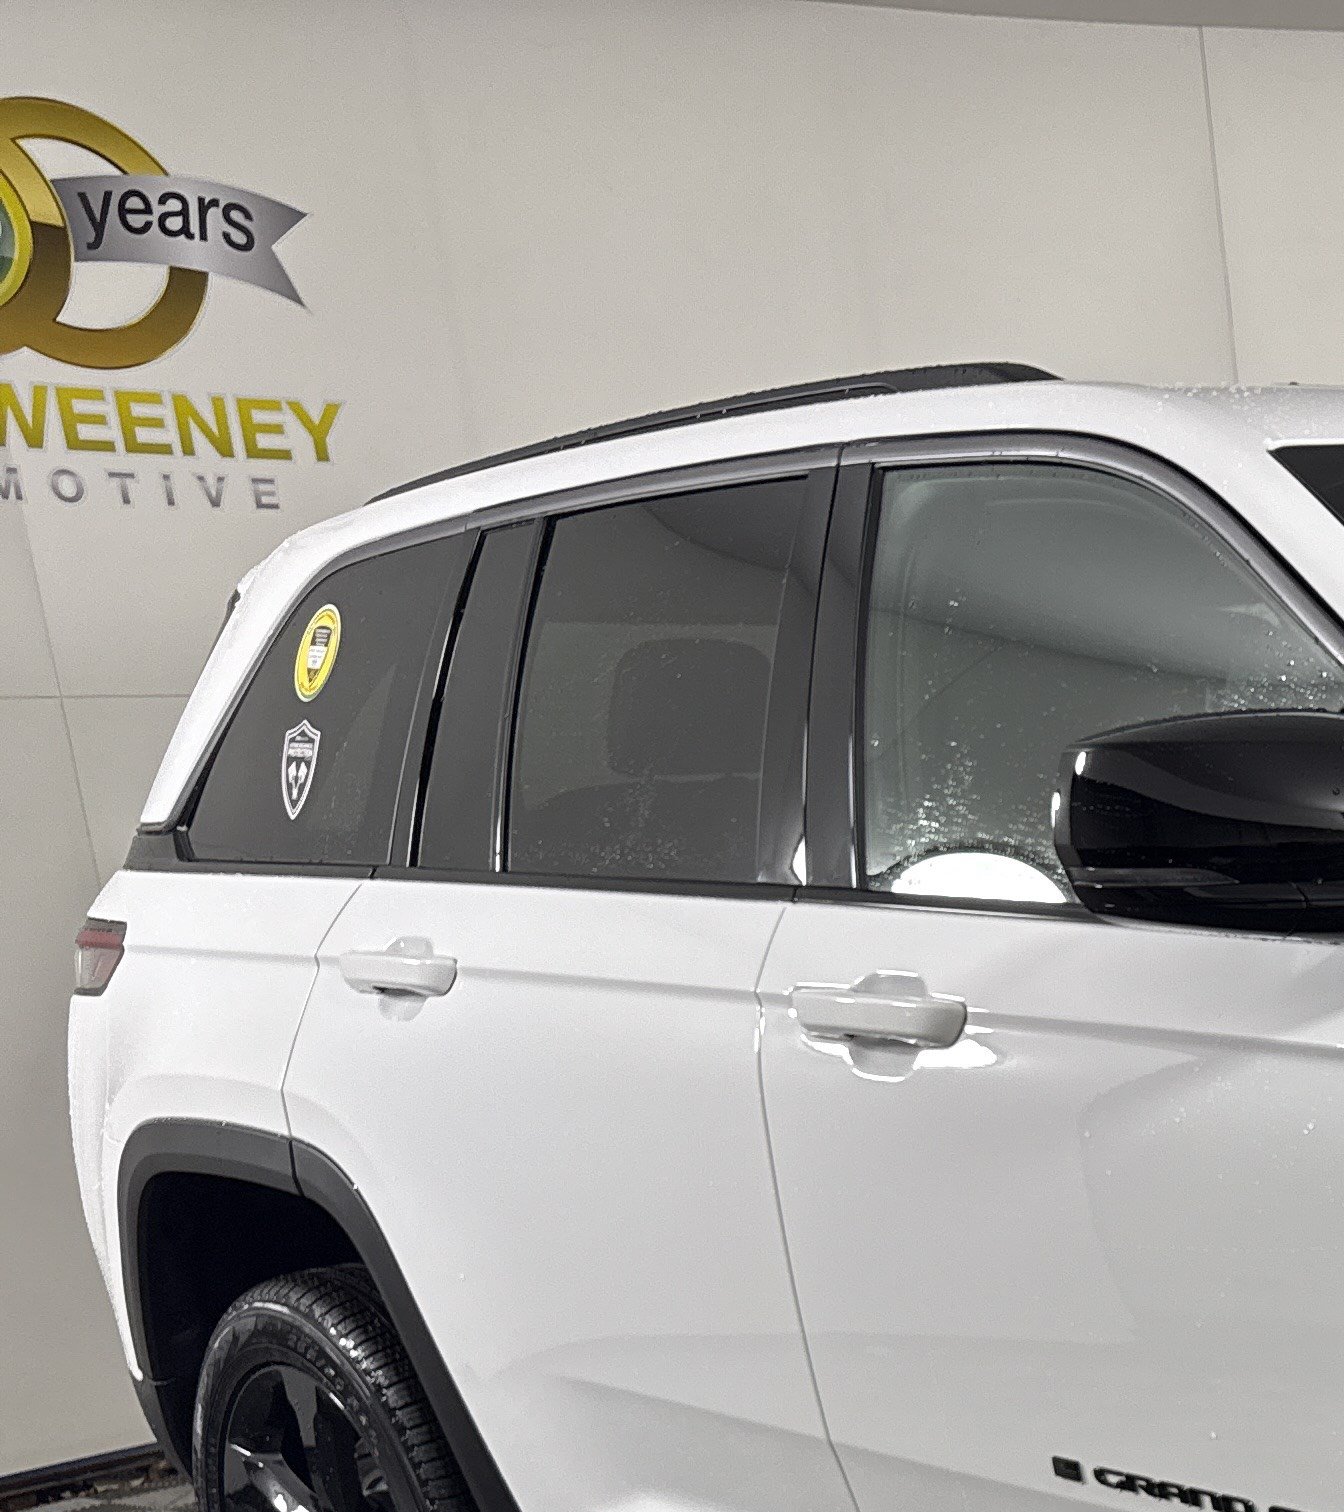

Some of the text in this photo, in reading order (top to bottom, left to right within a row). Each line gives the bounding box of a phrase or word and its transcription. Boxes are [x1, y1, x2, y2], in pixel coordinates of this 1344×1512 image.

[77, 189, 256, 252] years
[0, 382, 344, 462] WEENEY
[0, 466, 281, 510] MOTIVE
